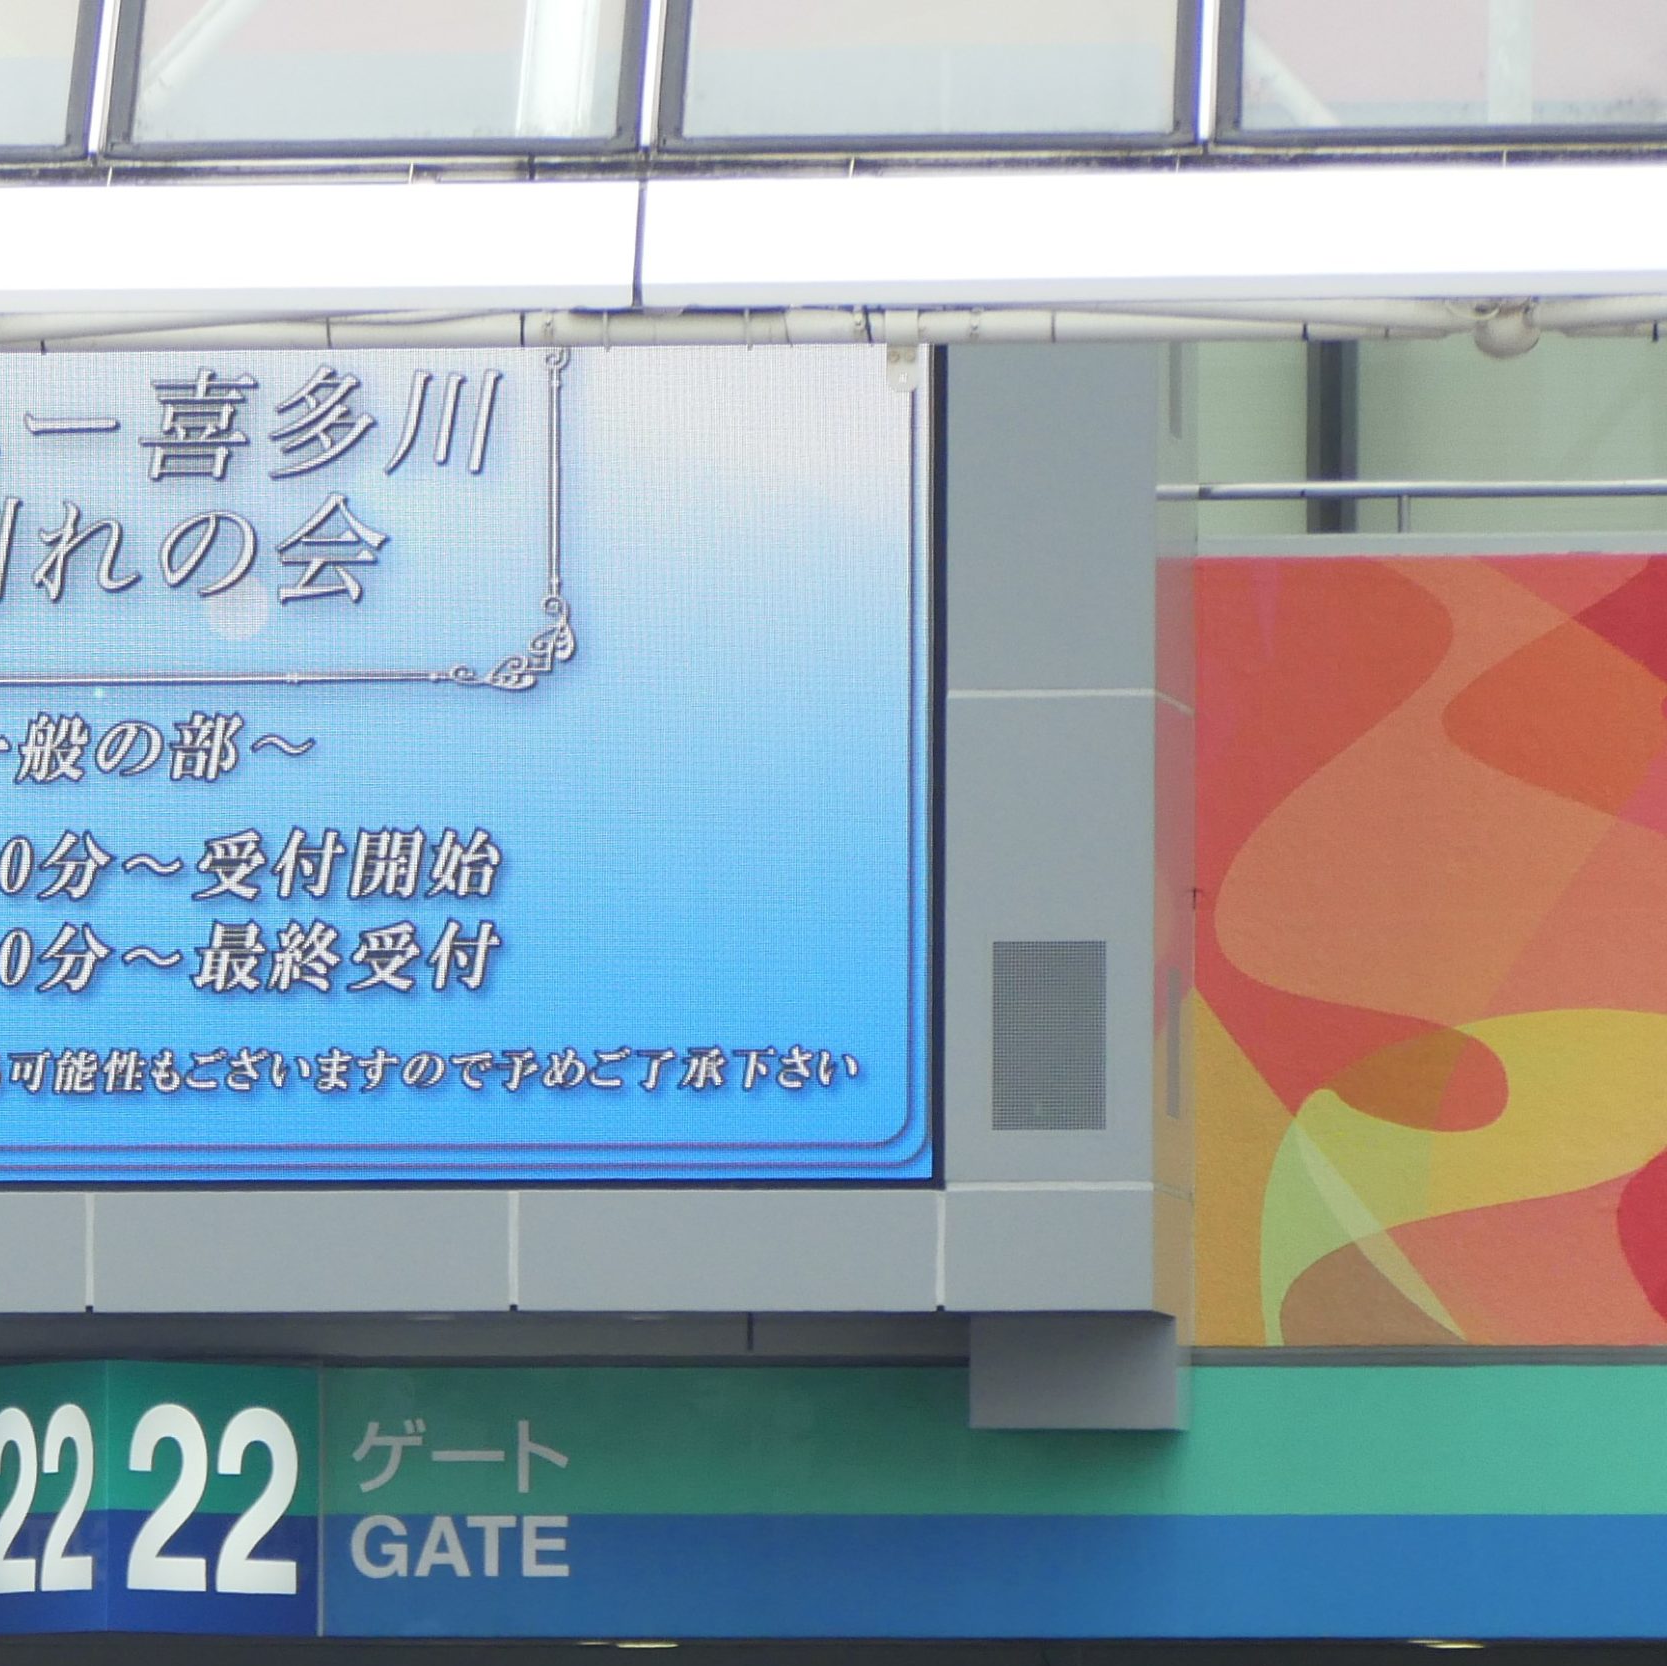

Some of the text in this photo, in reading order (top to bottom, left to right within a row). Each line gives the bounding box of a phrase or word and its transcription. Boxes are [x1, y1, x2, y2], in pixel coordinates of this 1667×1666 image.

[351, 1417, 570, 1494] ゲート
[126, 1402, 299, 1596] 22
[349, 1513, 571, 1579] GATE
